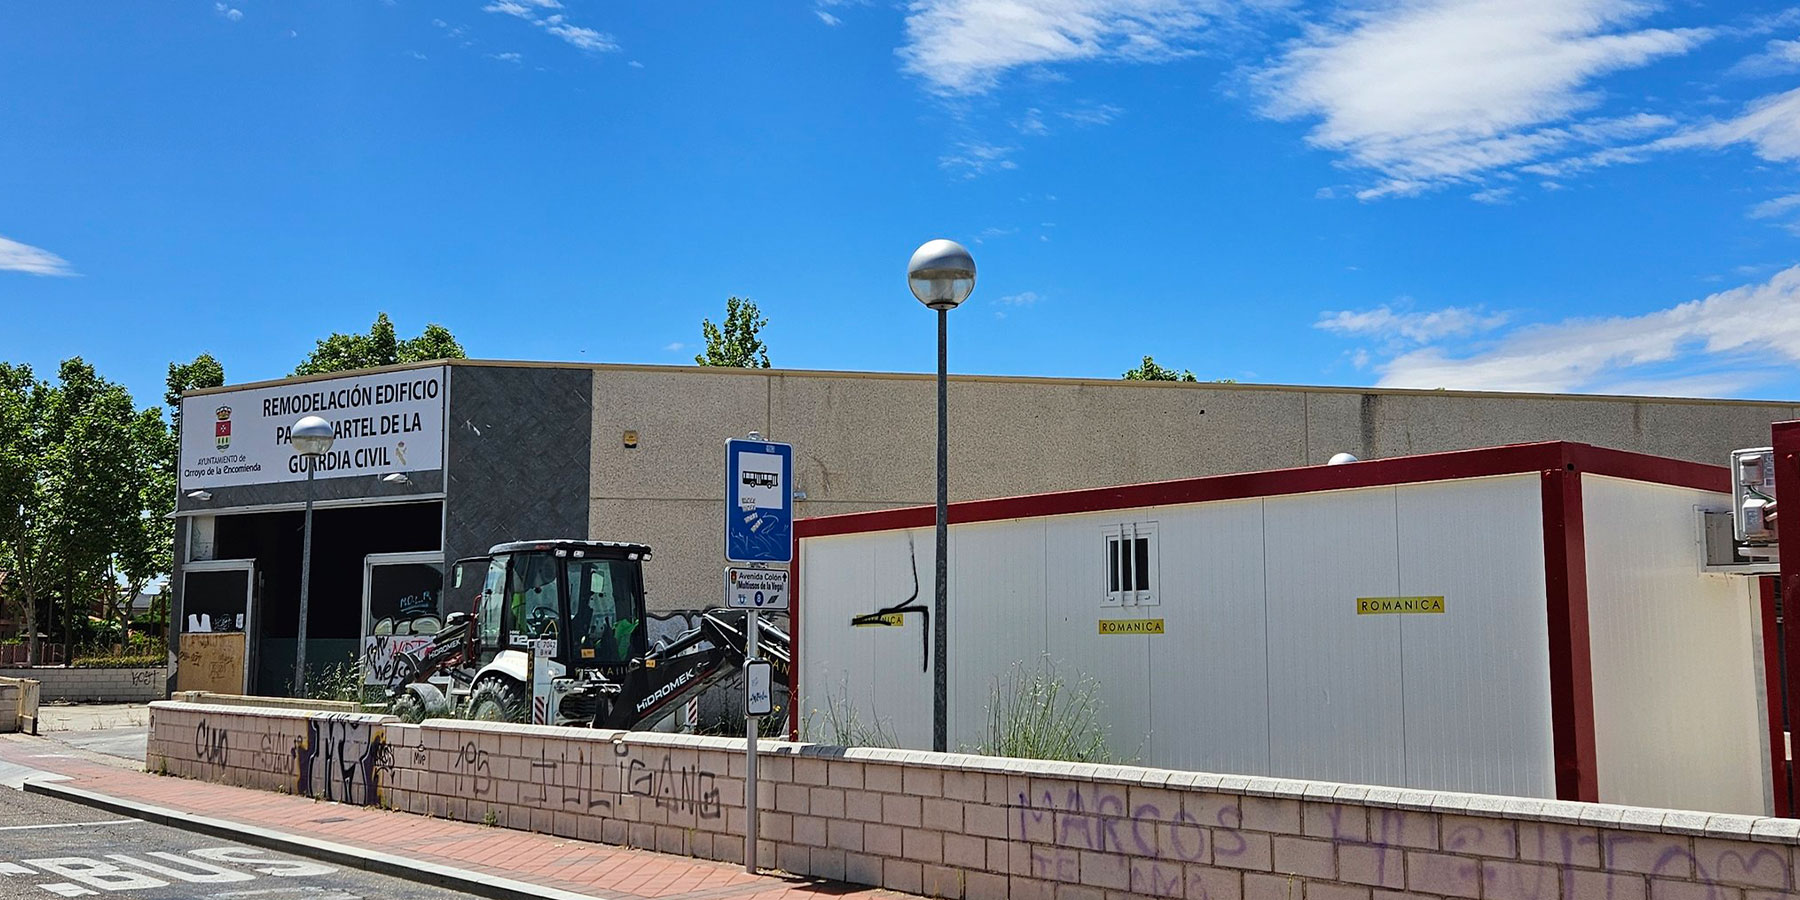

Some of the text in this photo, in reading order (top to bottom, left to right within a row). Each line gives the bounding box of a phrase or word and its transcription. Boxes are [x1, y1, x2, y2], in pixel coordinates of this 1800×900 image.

[263, 379, 439, 417] REMODELACIÓN EDIFICIO
[330, 417, 377, 440] ARTEL
[380, 414, 400, 435] DE
[403, 412, 422, 433] LA
[198, 454, 246, 466] AYUNTAMIENTO de
[354, 446, 391, 468] CIVIL
[207, 467, 214, 476] de
[215, 466, 222, 475] la
[223, 463, 262, 474] Encomienda
[739, 572, 782, 581] Avenida Colón
[1361, 600, 1441, 611] ROMANICA
[1102, 621, 1162, 632] ROMANICA
[1018, 785, 1247, 861] MARCOS
[20, 847, 339, 891] BUS
